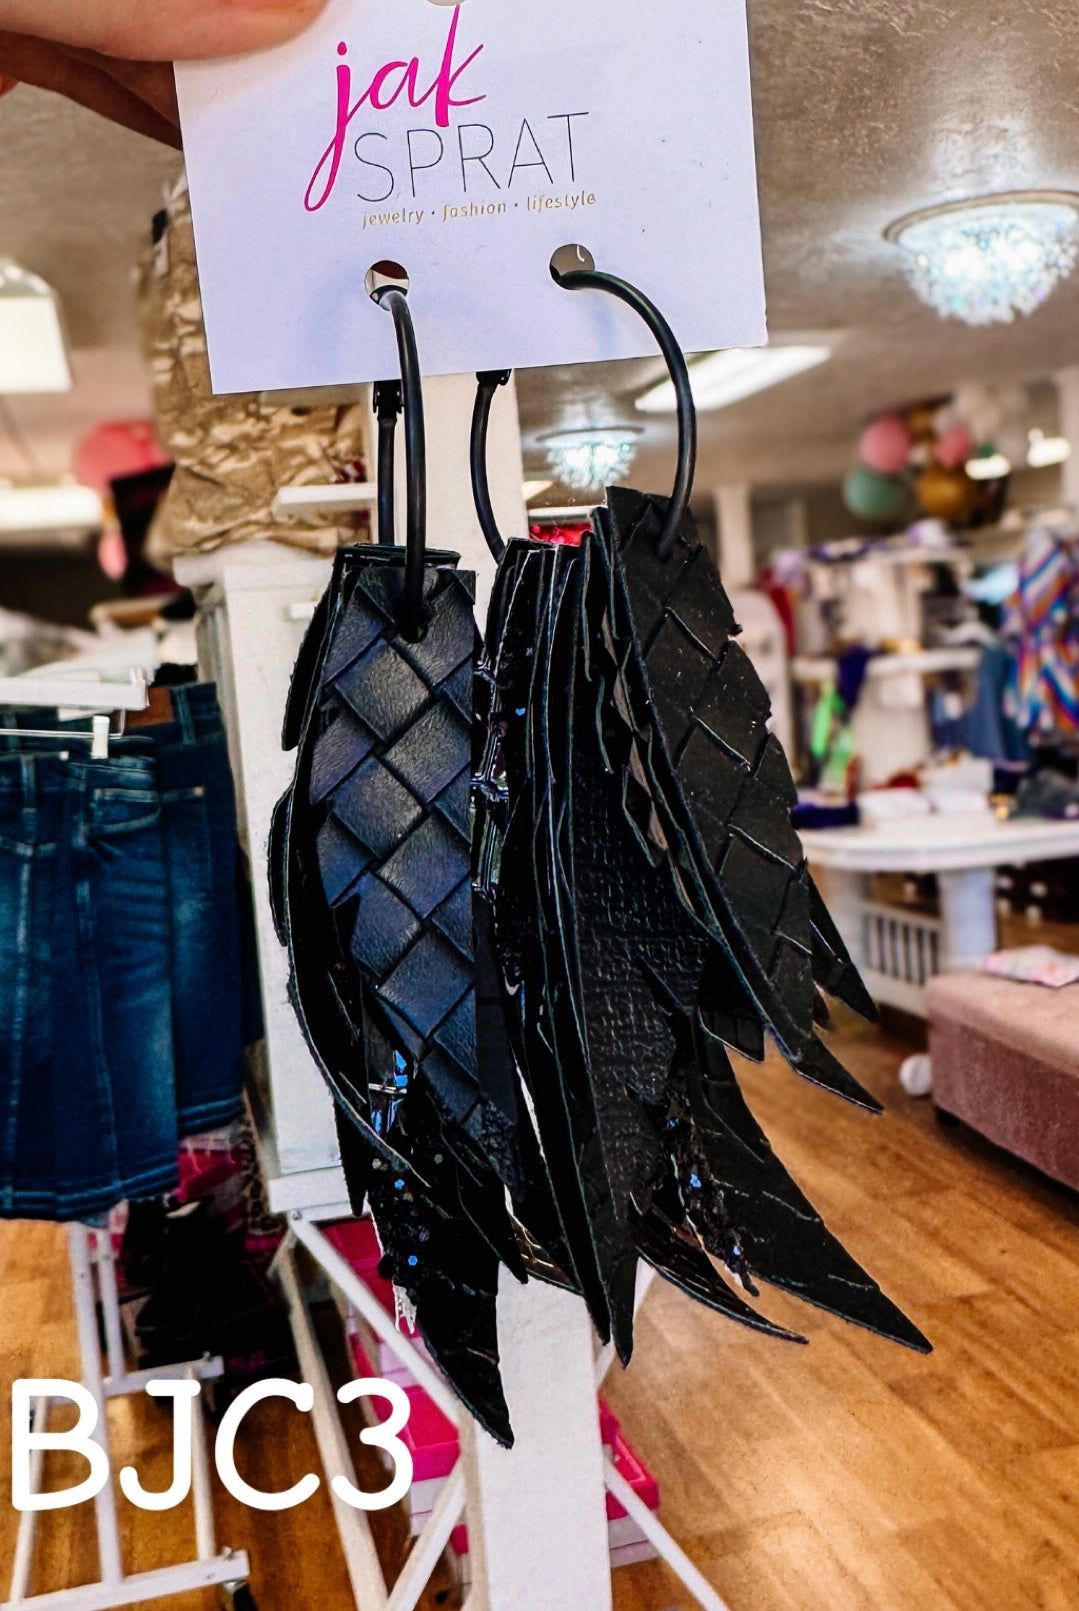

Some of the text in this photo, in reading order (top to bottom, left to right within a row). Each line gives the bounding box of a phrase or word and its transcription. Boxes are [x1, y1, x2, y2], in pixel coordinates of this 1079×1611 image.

[304, 3, 486, 212] jak
[353, 112, 590, 202] SPRAT
[362, 190, 597, 229] jewelry fashion lifestyle
